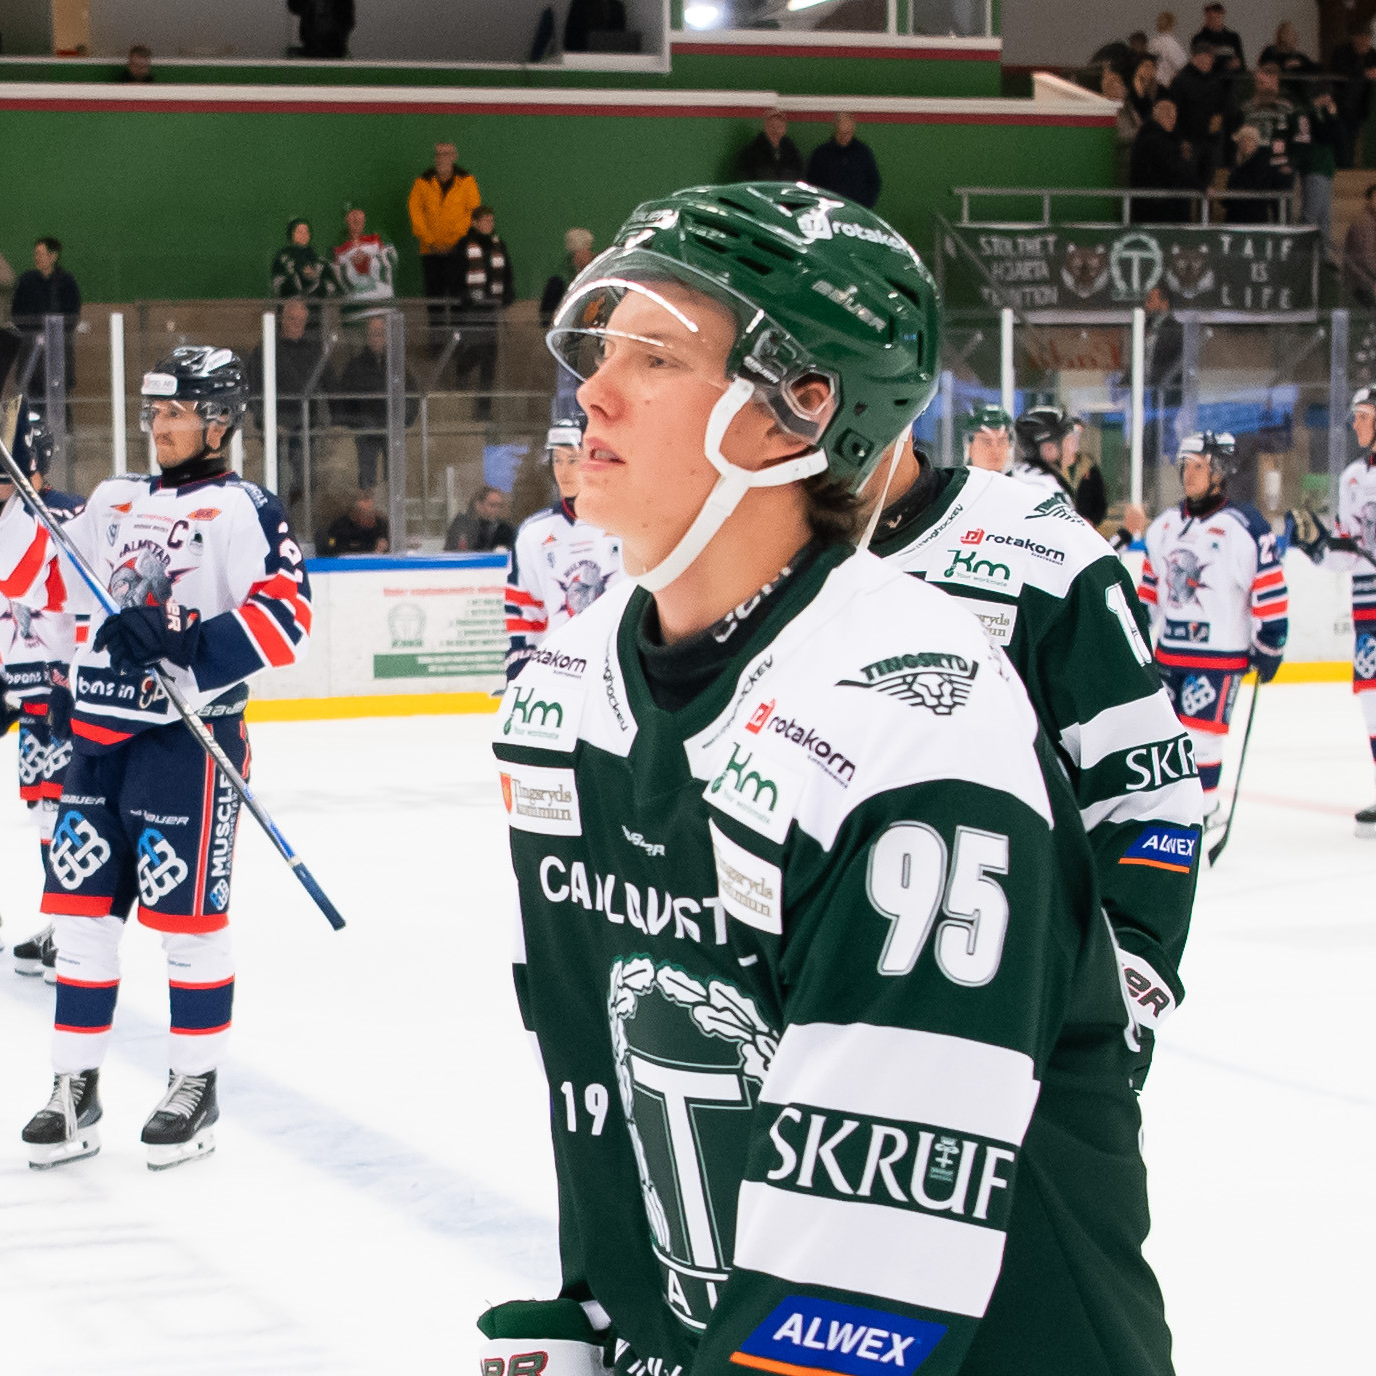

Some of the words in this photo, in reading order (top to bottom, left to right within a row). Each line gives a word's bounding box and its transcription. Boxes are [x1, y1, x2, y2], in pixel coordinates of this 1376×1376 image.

[985, 533, 1065, 562] rotakorn
[767, 714, 857, 783] rotakorn
[866, 819, 1010, 987] 95
[559, 1080, 609, 1137] 19
[767, 1106, 1016, 1220] SKRUF
[772, 1312, 916, 1367] ALWEX
